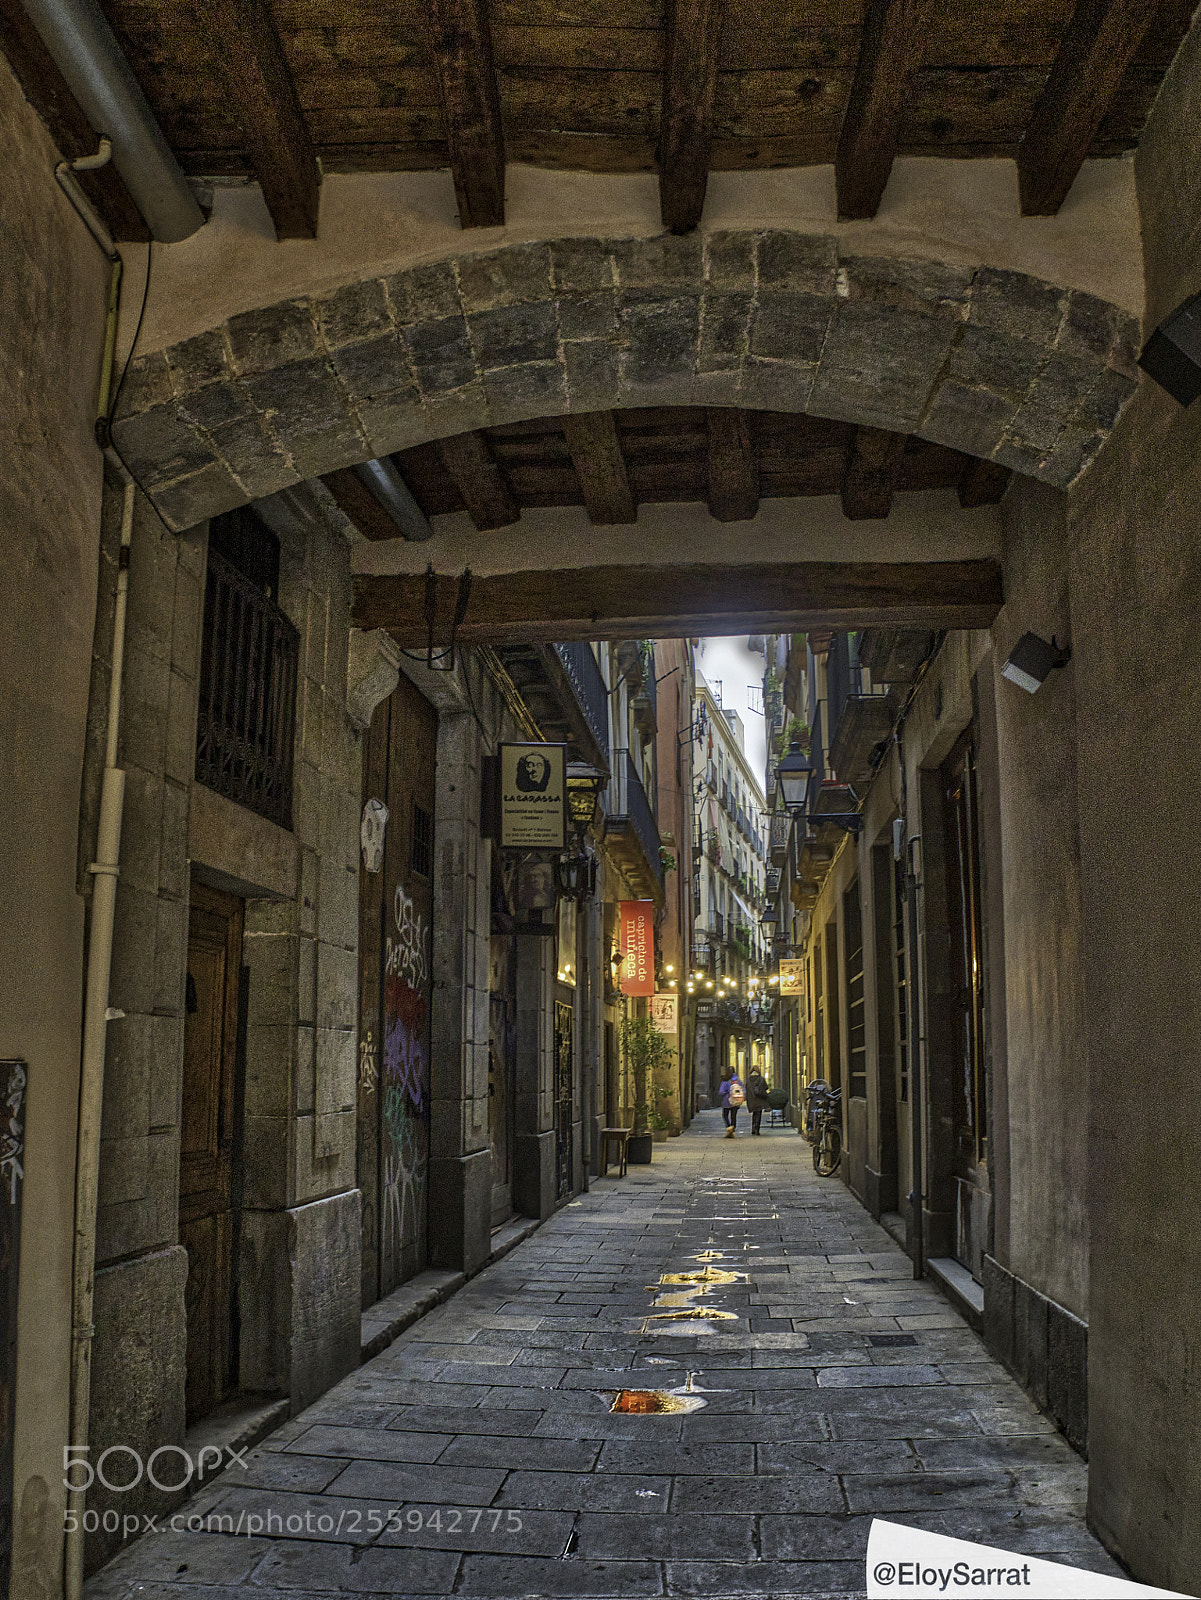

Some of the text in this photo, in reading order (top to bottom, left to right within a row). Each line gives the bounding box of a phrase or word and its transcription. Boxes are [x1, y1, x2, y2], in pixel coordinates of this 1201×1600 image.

[627, 920, 637, 979] muñeca
[636, 915, 647, 982] capricho de
